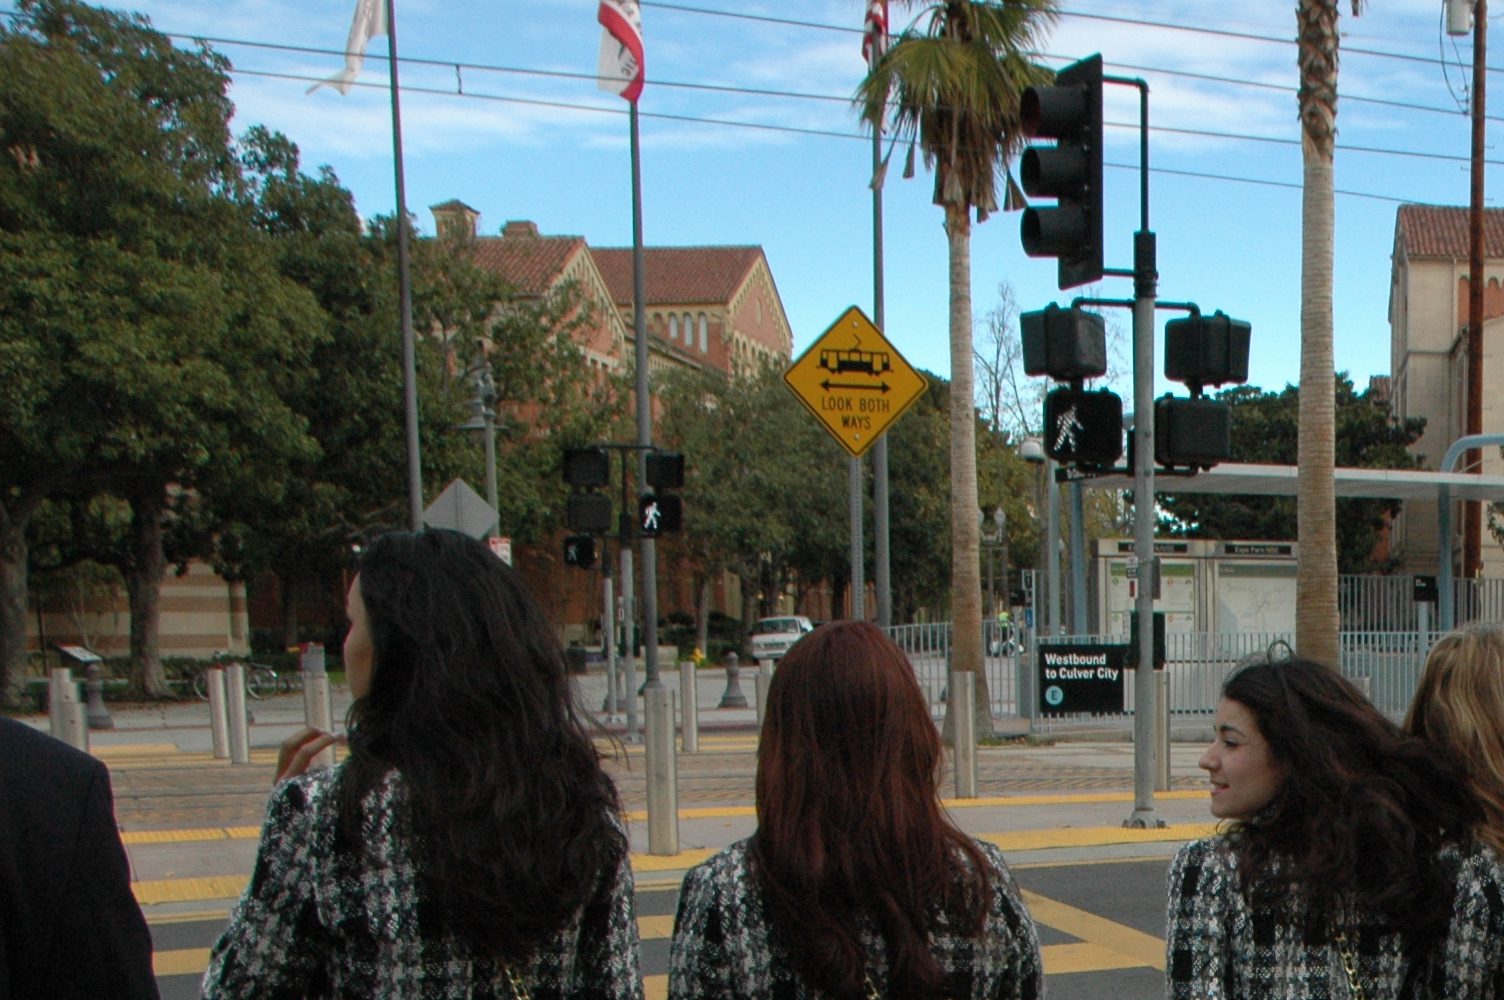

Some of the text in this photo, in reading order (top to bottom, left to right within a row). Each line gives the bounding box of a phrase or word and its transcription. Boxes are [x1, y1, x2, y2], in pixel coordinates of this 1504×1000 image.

[821, 396, 890, 413] LOOK BOTH
[841, 415, 871, 430] WAYS
[1045, 653, 1106, 665] Westbound
[1045, 667, 1119, 681] to Culver City
[1051, 690, 1057, 701] E
